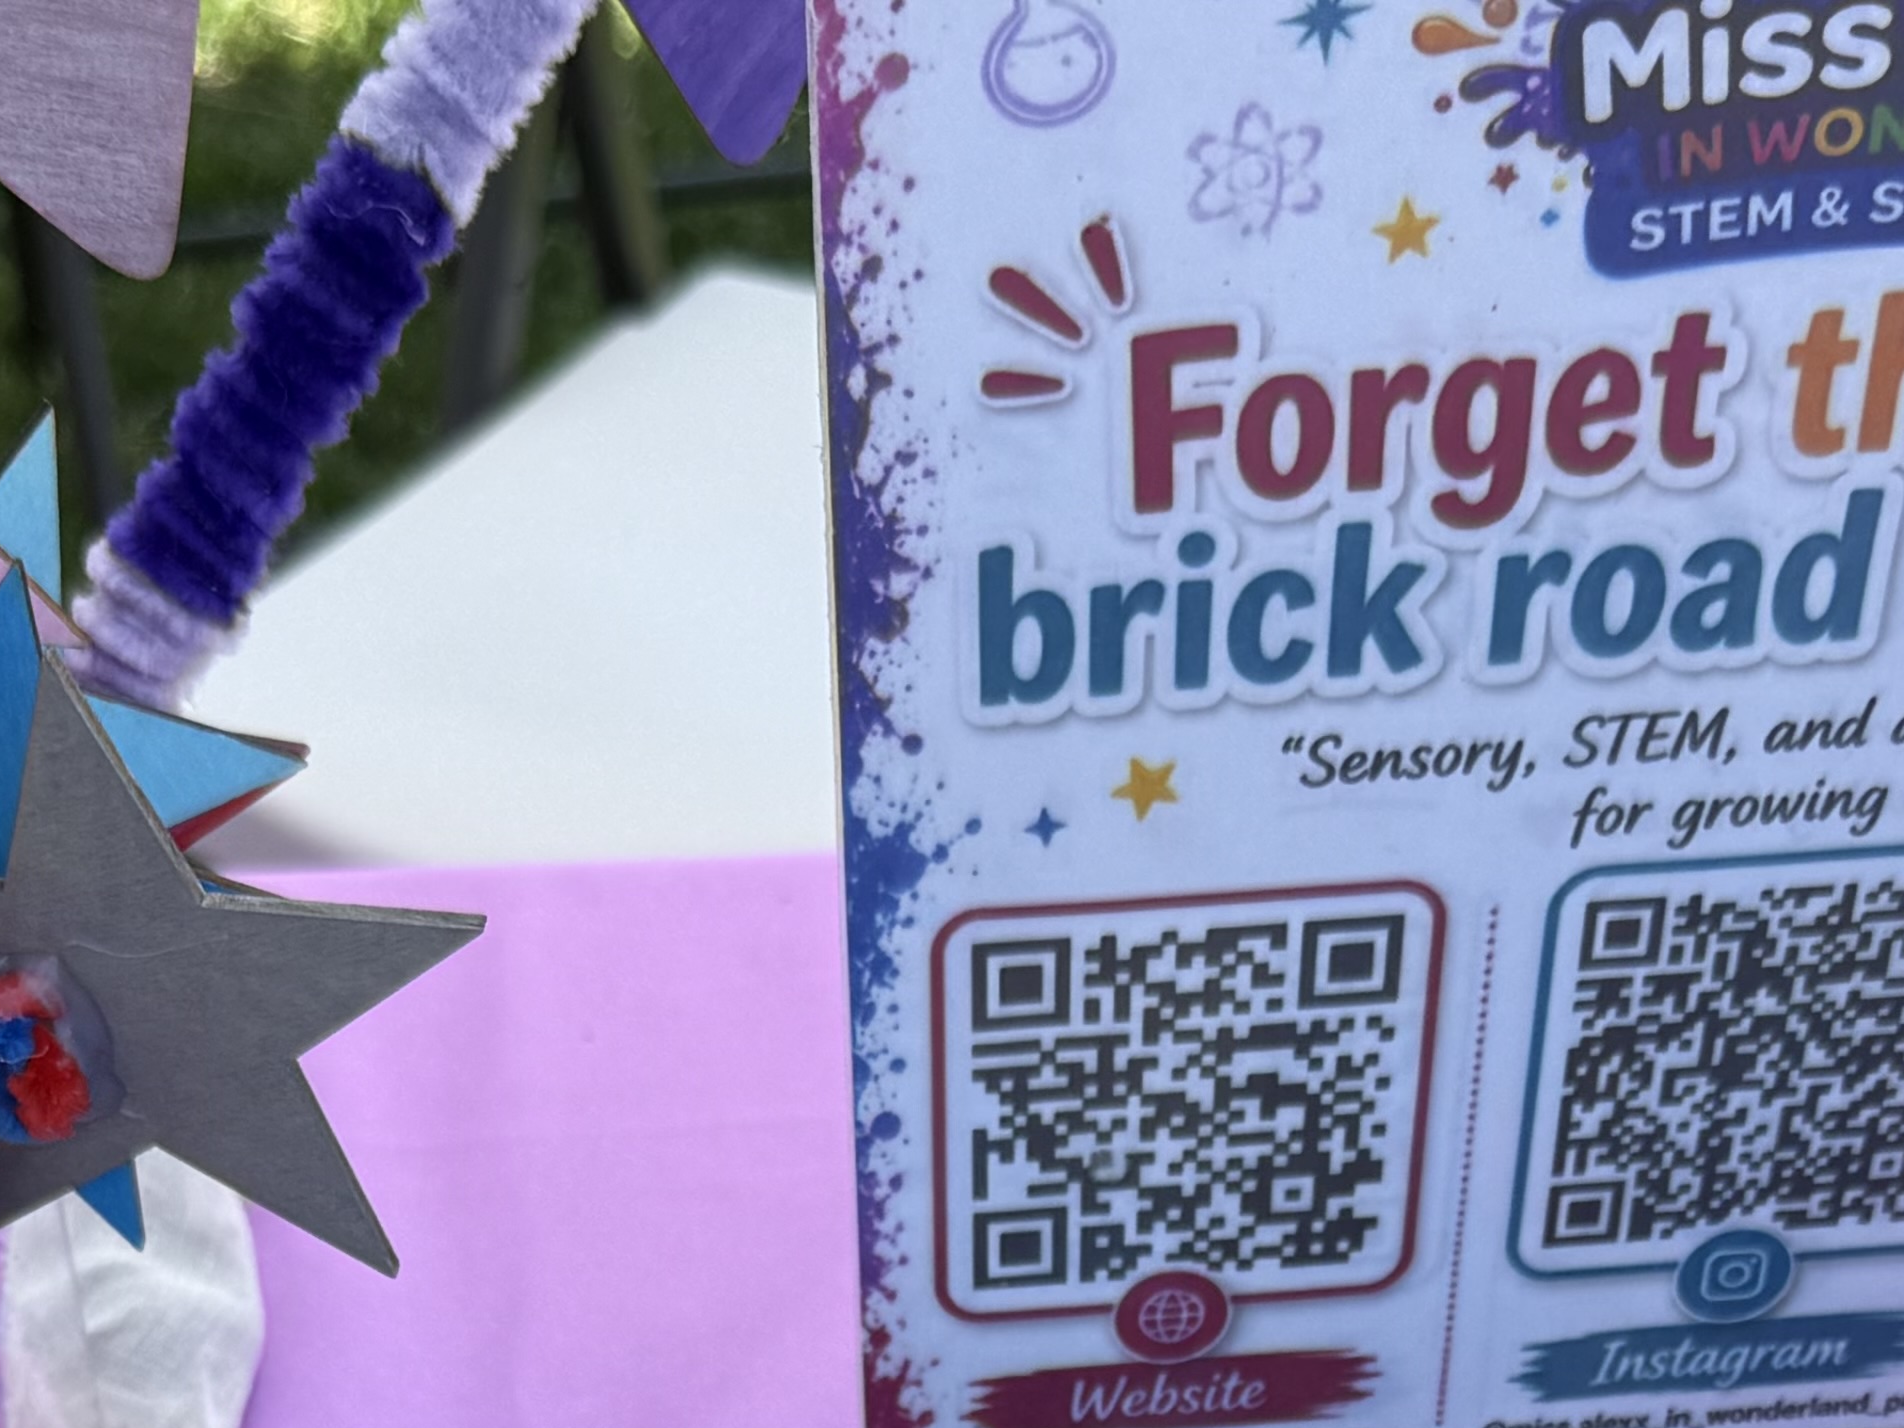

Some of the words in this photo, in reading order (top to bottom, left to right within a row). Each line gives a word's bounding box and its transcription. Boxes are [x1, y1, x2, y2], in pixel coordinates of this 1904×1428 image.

[1582, 0, 1892, 123] Miss
[1656, 124, 1723, 179] IN
[1629, 193, 1794, 251] STEM
[1811, 191, 1849, 227] &
[1130, 312, 1726, 529] Forget
[978, 521, 1434, 707] brick
[1487, 488, 1884, 667] road
[1562, 707, 1737, 768] STEM,
[1762, 697, 1879, 755] and
[1569, 786, 1654, 850] for
[1666, 778, 1888, 850] growing
[1069, 1370, 1268, 1423] Website
[1589, 1338, 1850, 1388] Instagram
